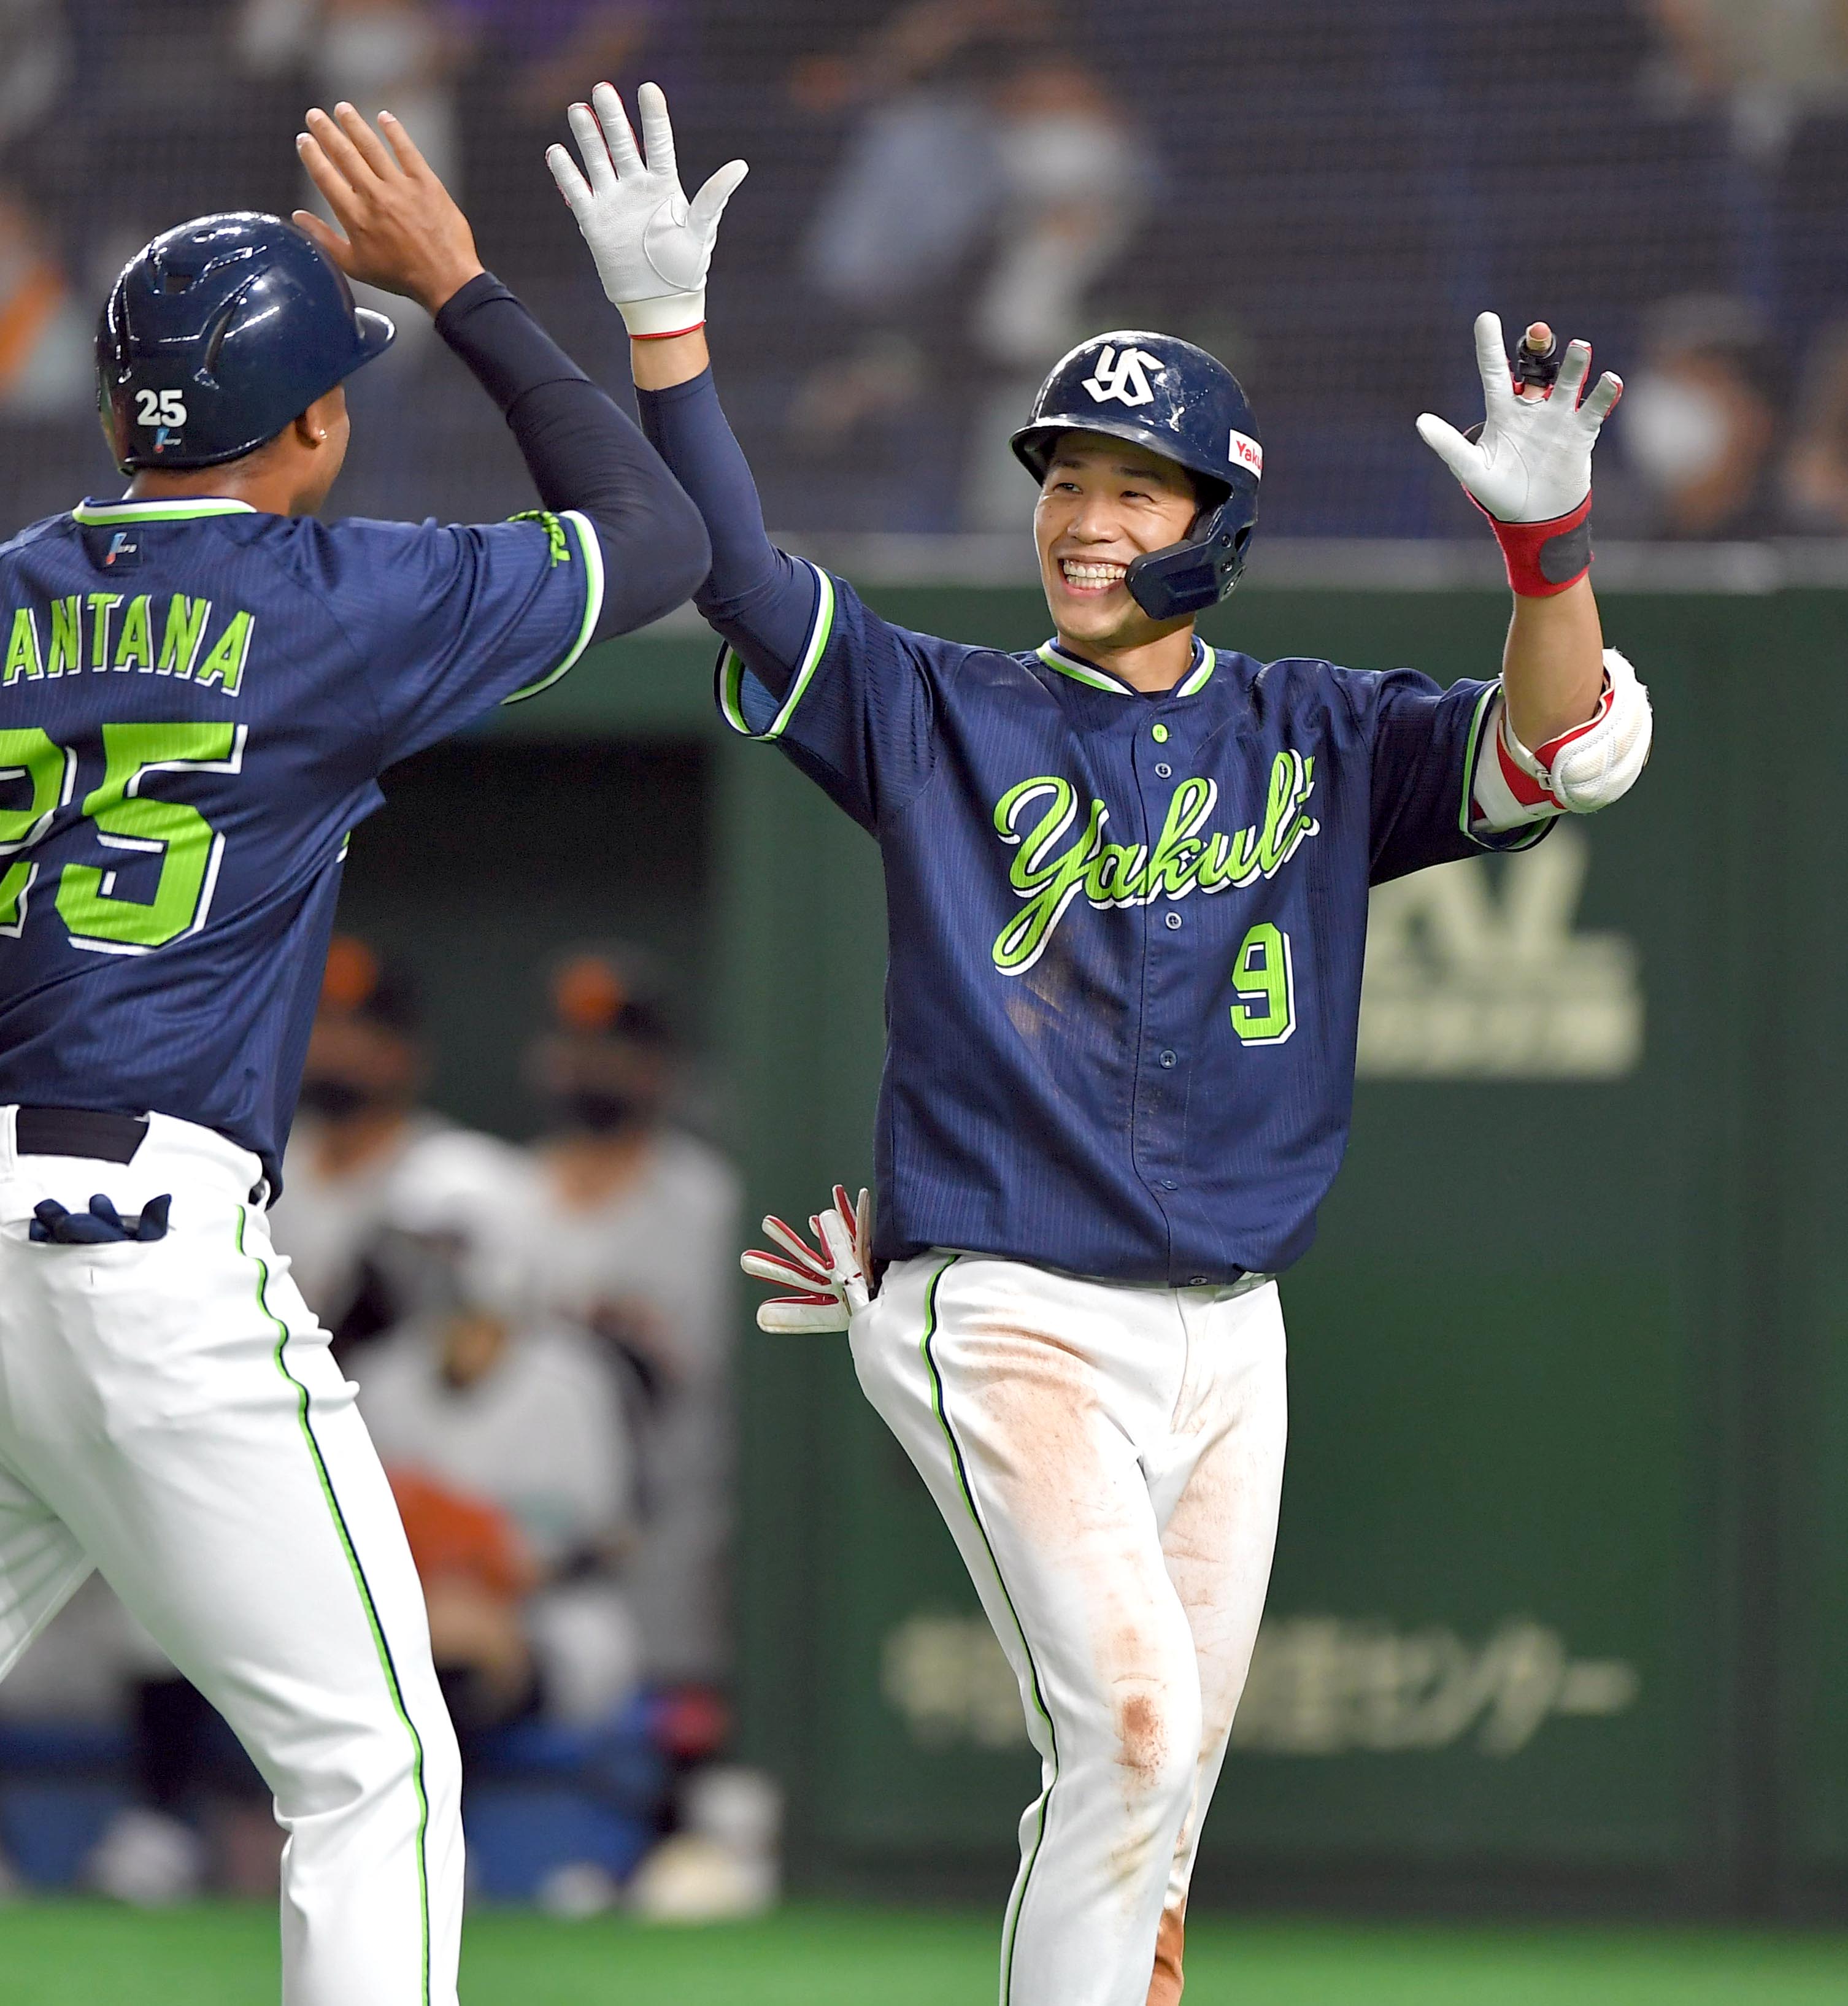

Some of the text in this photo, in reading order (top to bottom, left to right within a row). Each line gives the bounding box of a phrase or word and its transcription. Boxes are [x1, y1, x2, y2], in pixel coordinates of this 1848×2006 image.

[134, 389, 187, 428] 25
[2, 593, 255, 697] ANTANA
[992, 748, 1320, 975] Yakult
[1230, 922, 1296, 1047] 9
